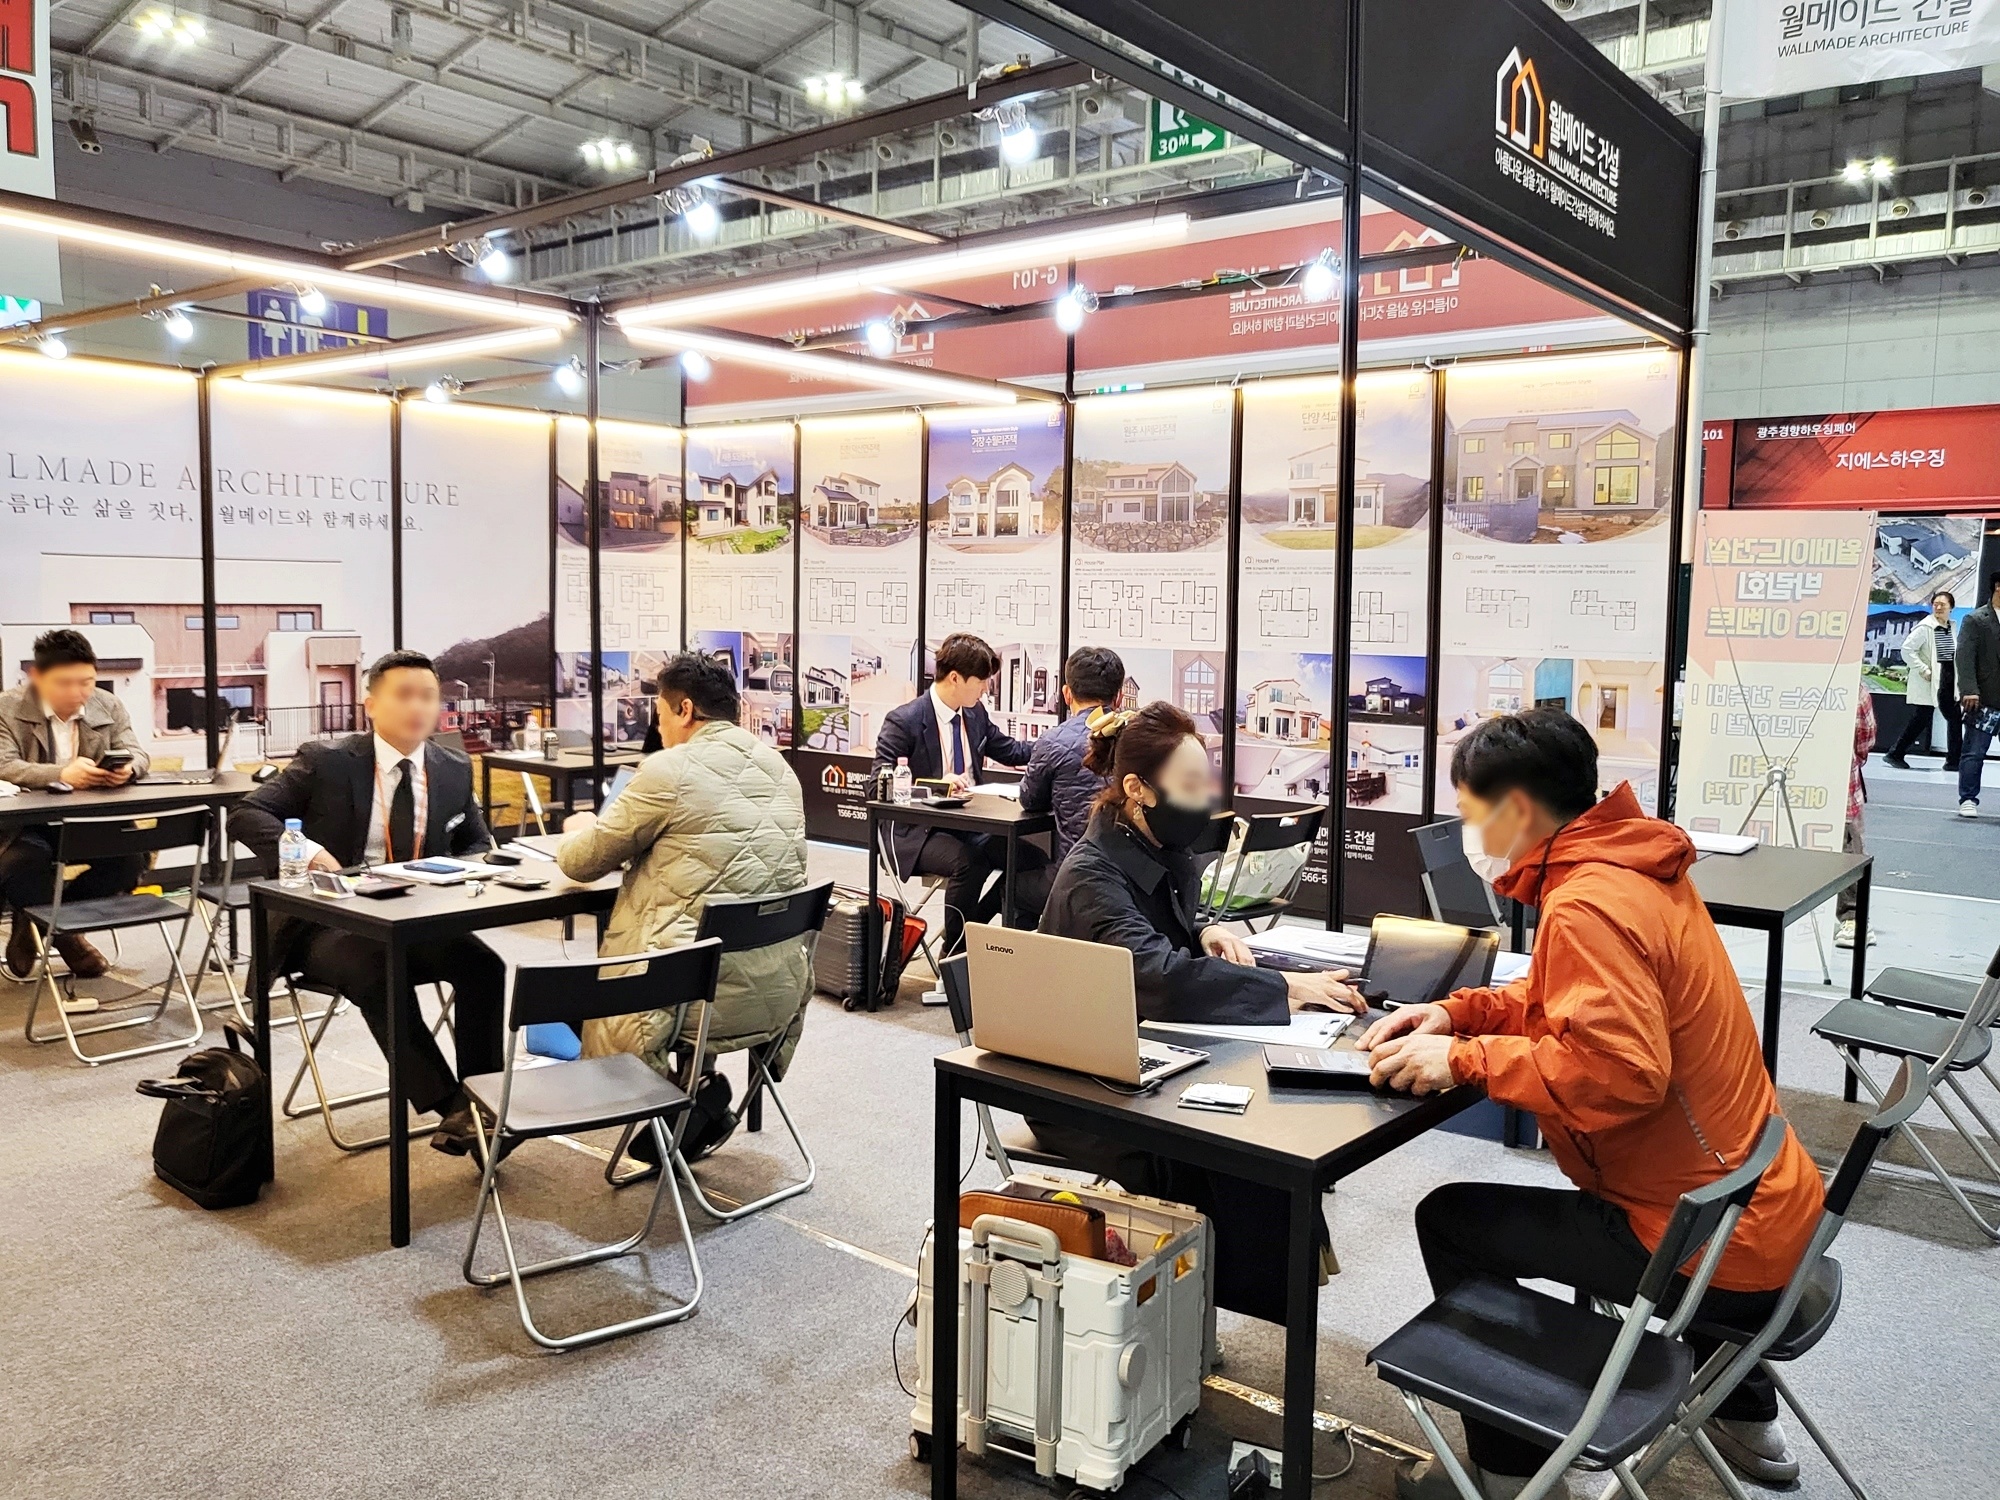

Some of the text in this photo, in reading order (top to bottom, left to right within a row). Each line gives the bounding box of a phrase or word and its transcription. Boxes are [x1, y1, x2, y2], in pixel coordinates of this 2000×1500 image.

[1779, 0, 1901, 40] 월메이드
[1777, 20, 1970, 58] WALLMADE ARCHITECTURE
[1549, 100, 1619, 188] 월메이드 건설
[1495, 147, 1523, 184] 아름다운
[1522, 163, 1536, 193] 삶을
[1550, 181, 1589, 223] 월메이드건설과
[1548, 148, 1618, 208] WALLMADE ARCHITECTURE
[1756, 422, 1856, 439] 광주경향하우징페어
[1836, 449, 1946, 471] 지에스하우징
[176, 464, 460, 508] ARCHITECTURE
[0, 492, 79, 517] 름다운
[93, 498, 136, 520] 삶을
[148, 501, 193, 522] 짓다.
[218, 504, 313, 527] 월메이드와
[1354, 831, 1375, 845] 건설
[1301, 872, 1328, 885] 566-5
[985, 943, 1014, 955] Lenovo
